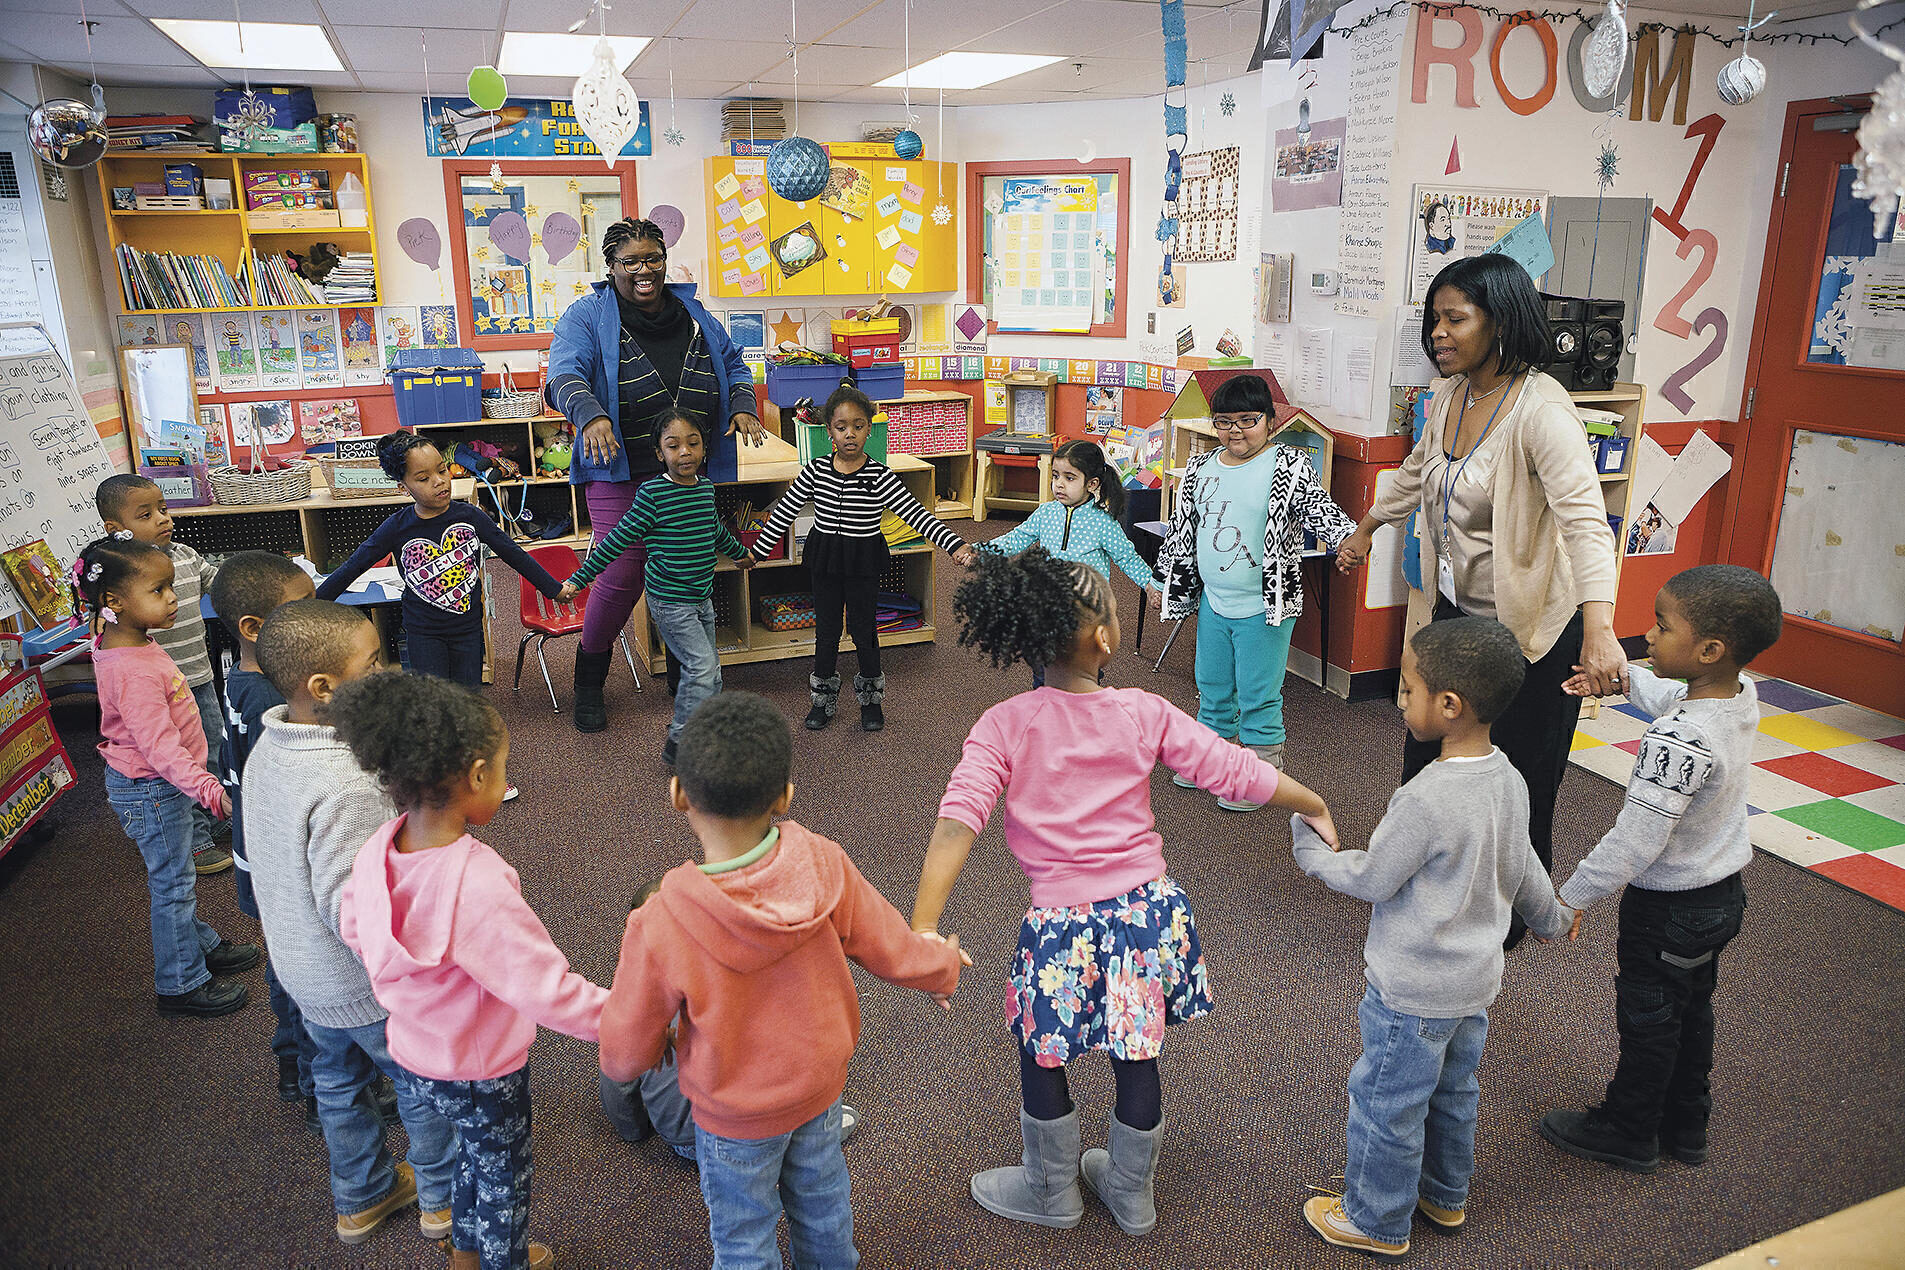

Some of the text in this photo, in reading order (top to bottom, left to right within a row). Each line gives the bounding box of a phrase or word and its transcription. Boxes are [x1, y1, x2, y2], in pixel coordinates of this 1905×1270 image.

[1411, 2, 1696, 125] ROOM
[129, 137, 141, 145] KIT
[554, 138, 601, 155] STA
[736, 144, 752, 153] 800
[1031, 185, 1062, 195] Feelings
[1064, 185, 1085, 194] Chart
[1467, 222, 1483, 230] Please
[493, 221, 525, 245] Happy
[546, 223, 580, 243] Birthday
[1652, 113, 1728, 415] 122
[955, 344, 986, 352] diamond
[925, 358, 936, 368] 14
[946, 357, 957, 367] 15
[967, 357, 978, 367] 16
[991, 357, 1002, 367] 17
[1019, 359, 1030, 368] 18
[1048, 360, 1059, 369] 19
[1075, 361, 1089, 371] 20
[9, 361, 28, 378] and
[1105, 363, 1117, 372] 21
[1134, 364, 1143, 374] 22
[1150, 367, 1158, 377] 23
[309, 373, 337, 384] hopeful
[356, 372, 370, 381] shy
[1165, 370, 1175, 380] 24
[3, 388, 74, 417] your clothing
[338, 441, 378, 452] LOOKIN
[339, 450, 377, 459] DOWN
[46, 448, 66, 472] eight
[11, 468, 23, 483] or
[57, 473, 76, 488] nine
[77, 463, 98, 482] snaps
[338, 471, 392, 485] Science
[0, 496, 22, 521] nots
[67, 497, 84, 514] ten
[40, 519, 53, 535] or
[0, 777, 51, 836] December
